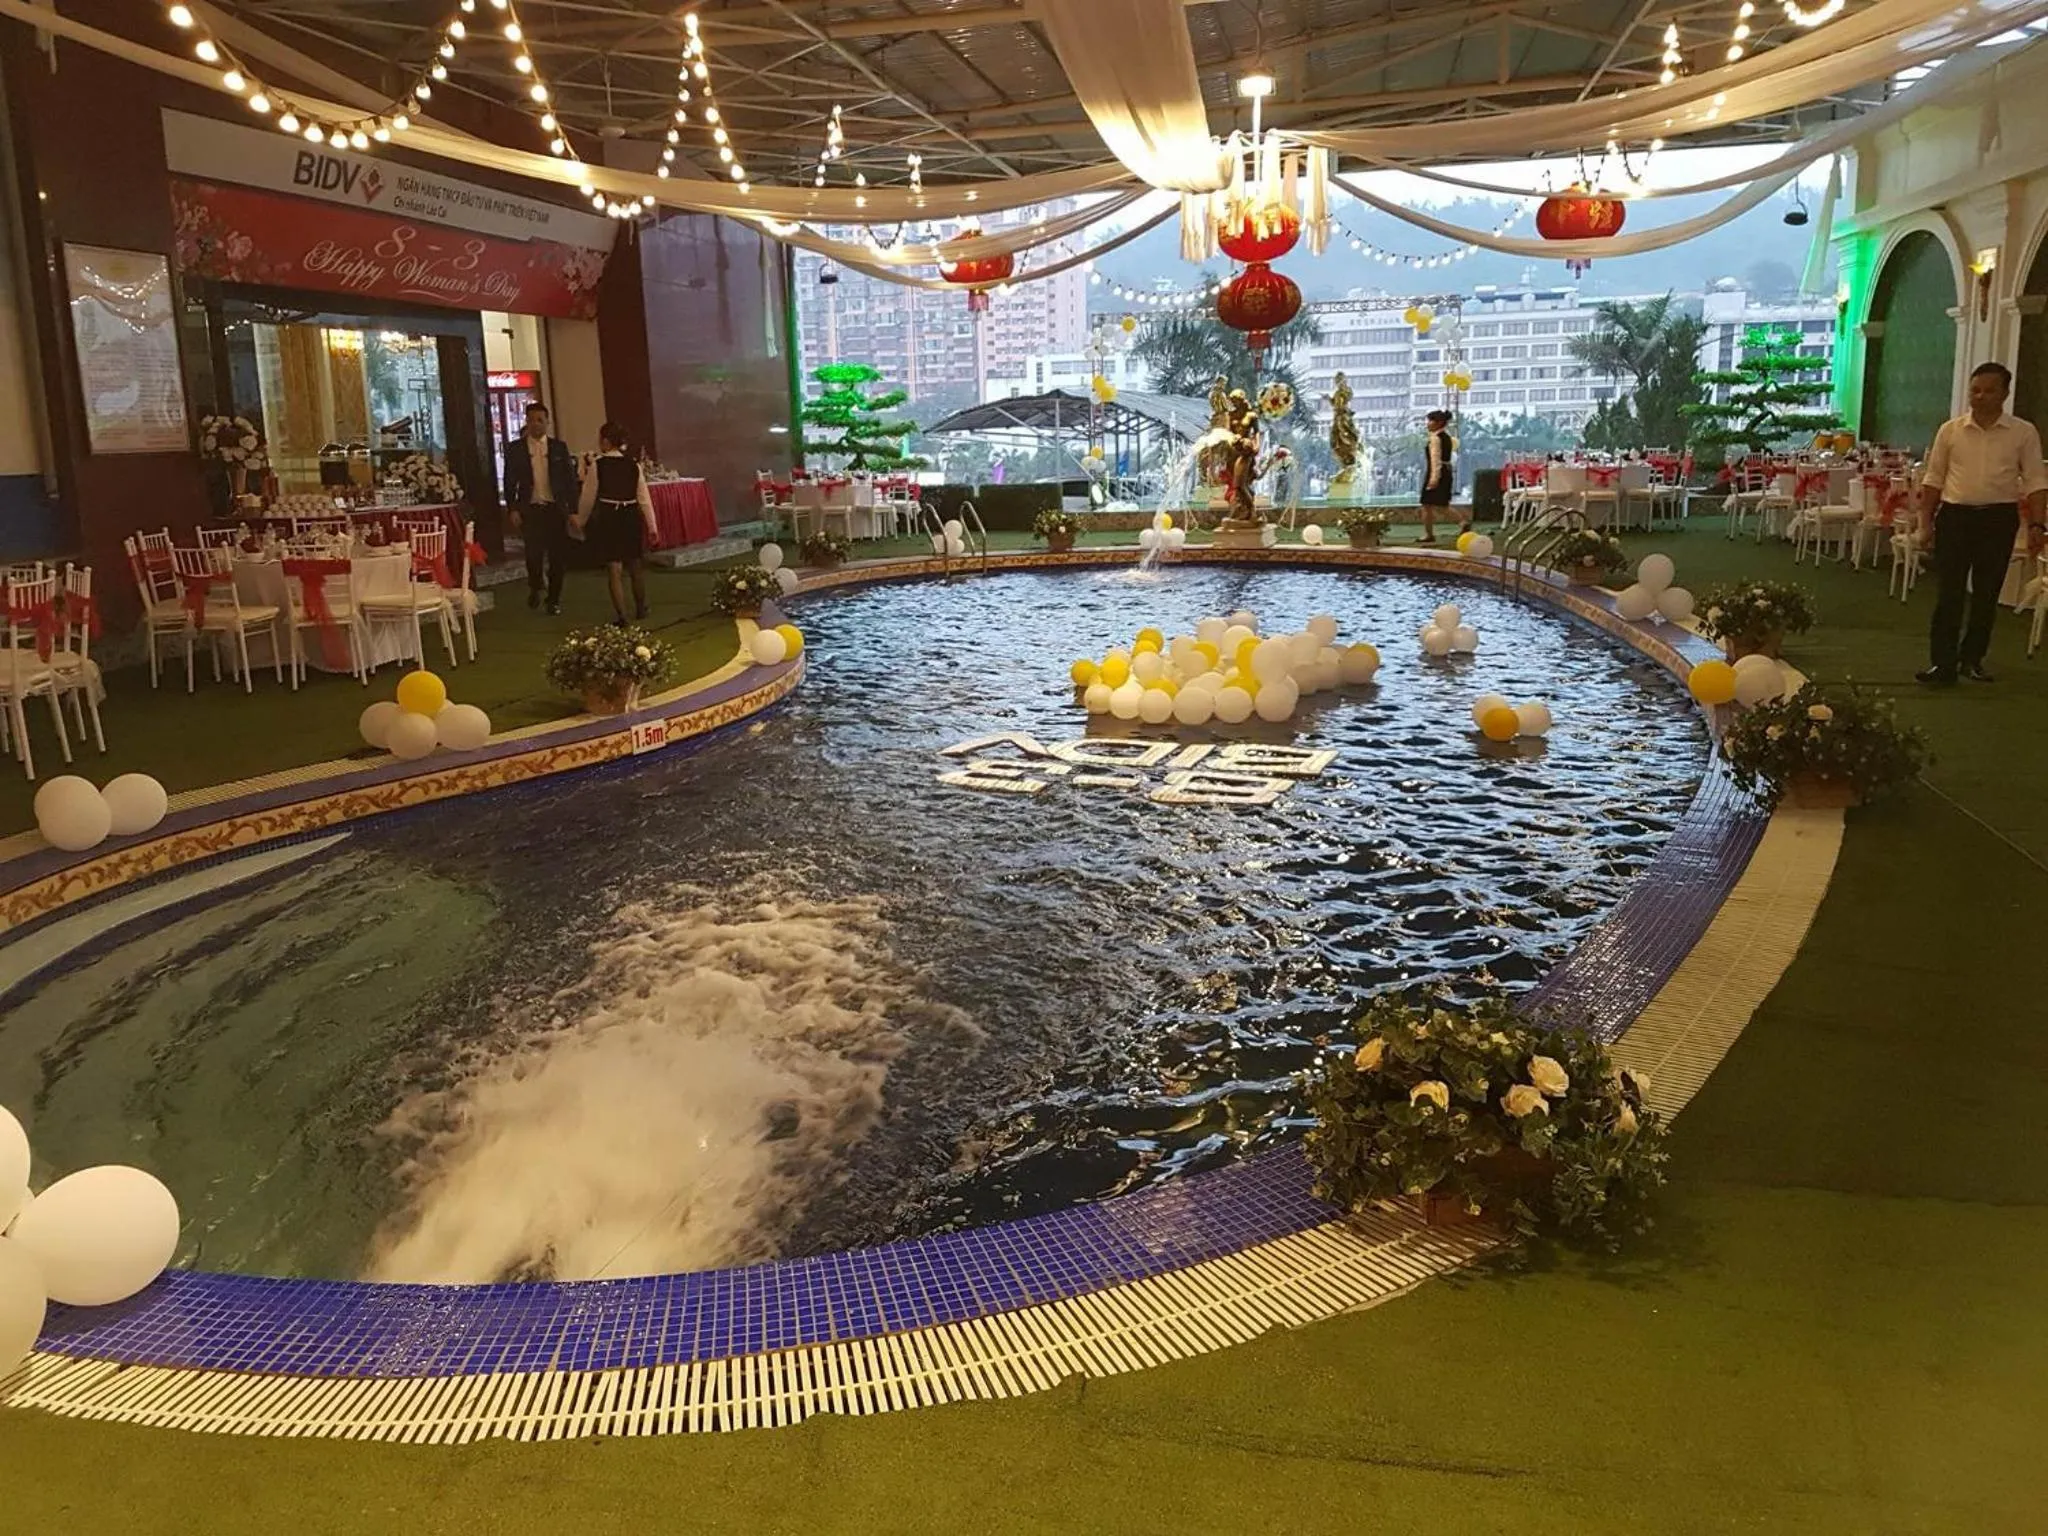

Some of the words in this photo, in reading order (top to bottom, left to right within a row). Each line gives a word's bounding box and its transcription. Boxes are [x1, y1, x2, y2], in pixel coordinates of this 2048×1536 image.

[293, 149, 361, 194] BIDV
[374, 225, 417, 258] 8
[453, 239, 486, 270] 3
[303, 240, 385, 292] Happy
[393, 255, 480, 296] Woman's
[486, 271, 520, 307] Day
[632, 727, 664, 749] 1.5m
